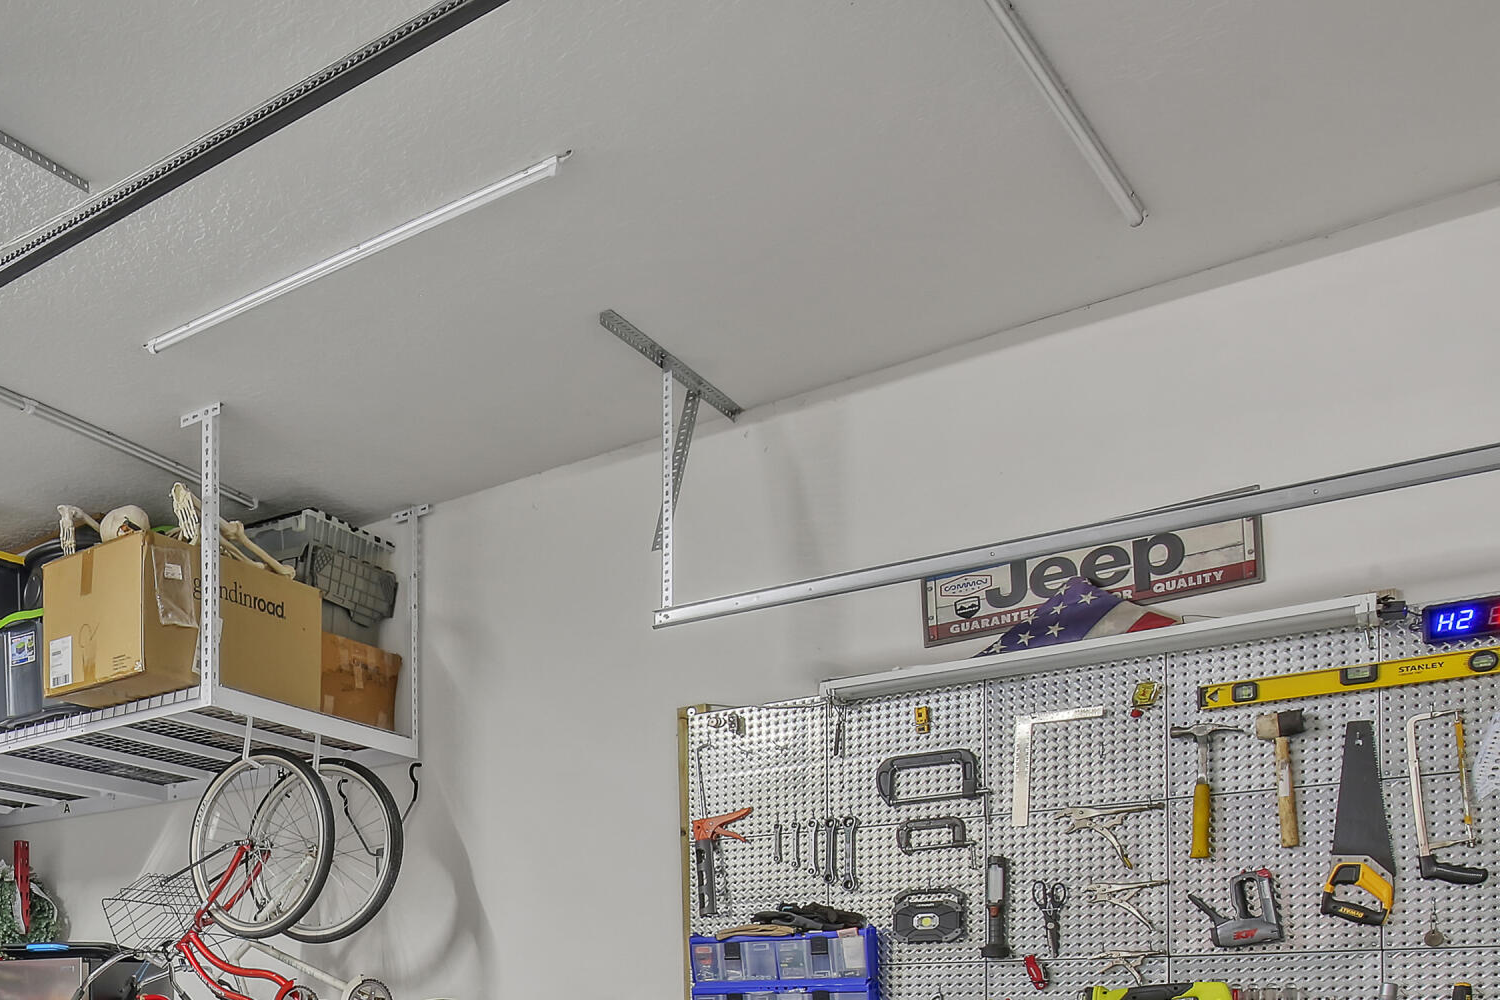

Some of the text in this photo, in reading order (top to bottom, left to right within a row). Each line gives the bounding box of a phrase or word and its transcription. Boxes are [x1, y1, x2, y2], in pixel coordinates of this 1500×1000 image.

[984, 531, 1186, 609] Jeep
[1152, 570, 1225, 594] QUALITY
[950, 608, 1038, 634] GUARANTE
[1112, 589, 1133, 601] OR
[1398, 661, 1445, 673] STANLEY
[63, 804, 71, 815] A
[1233, 928, 1259, 941] ACE
